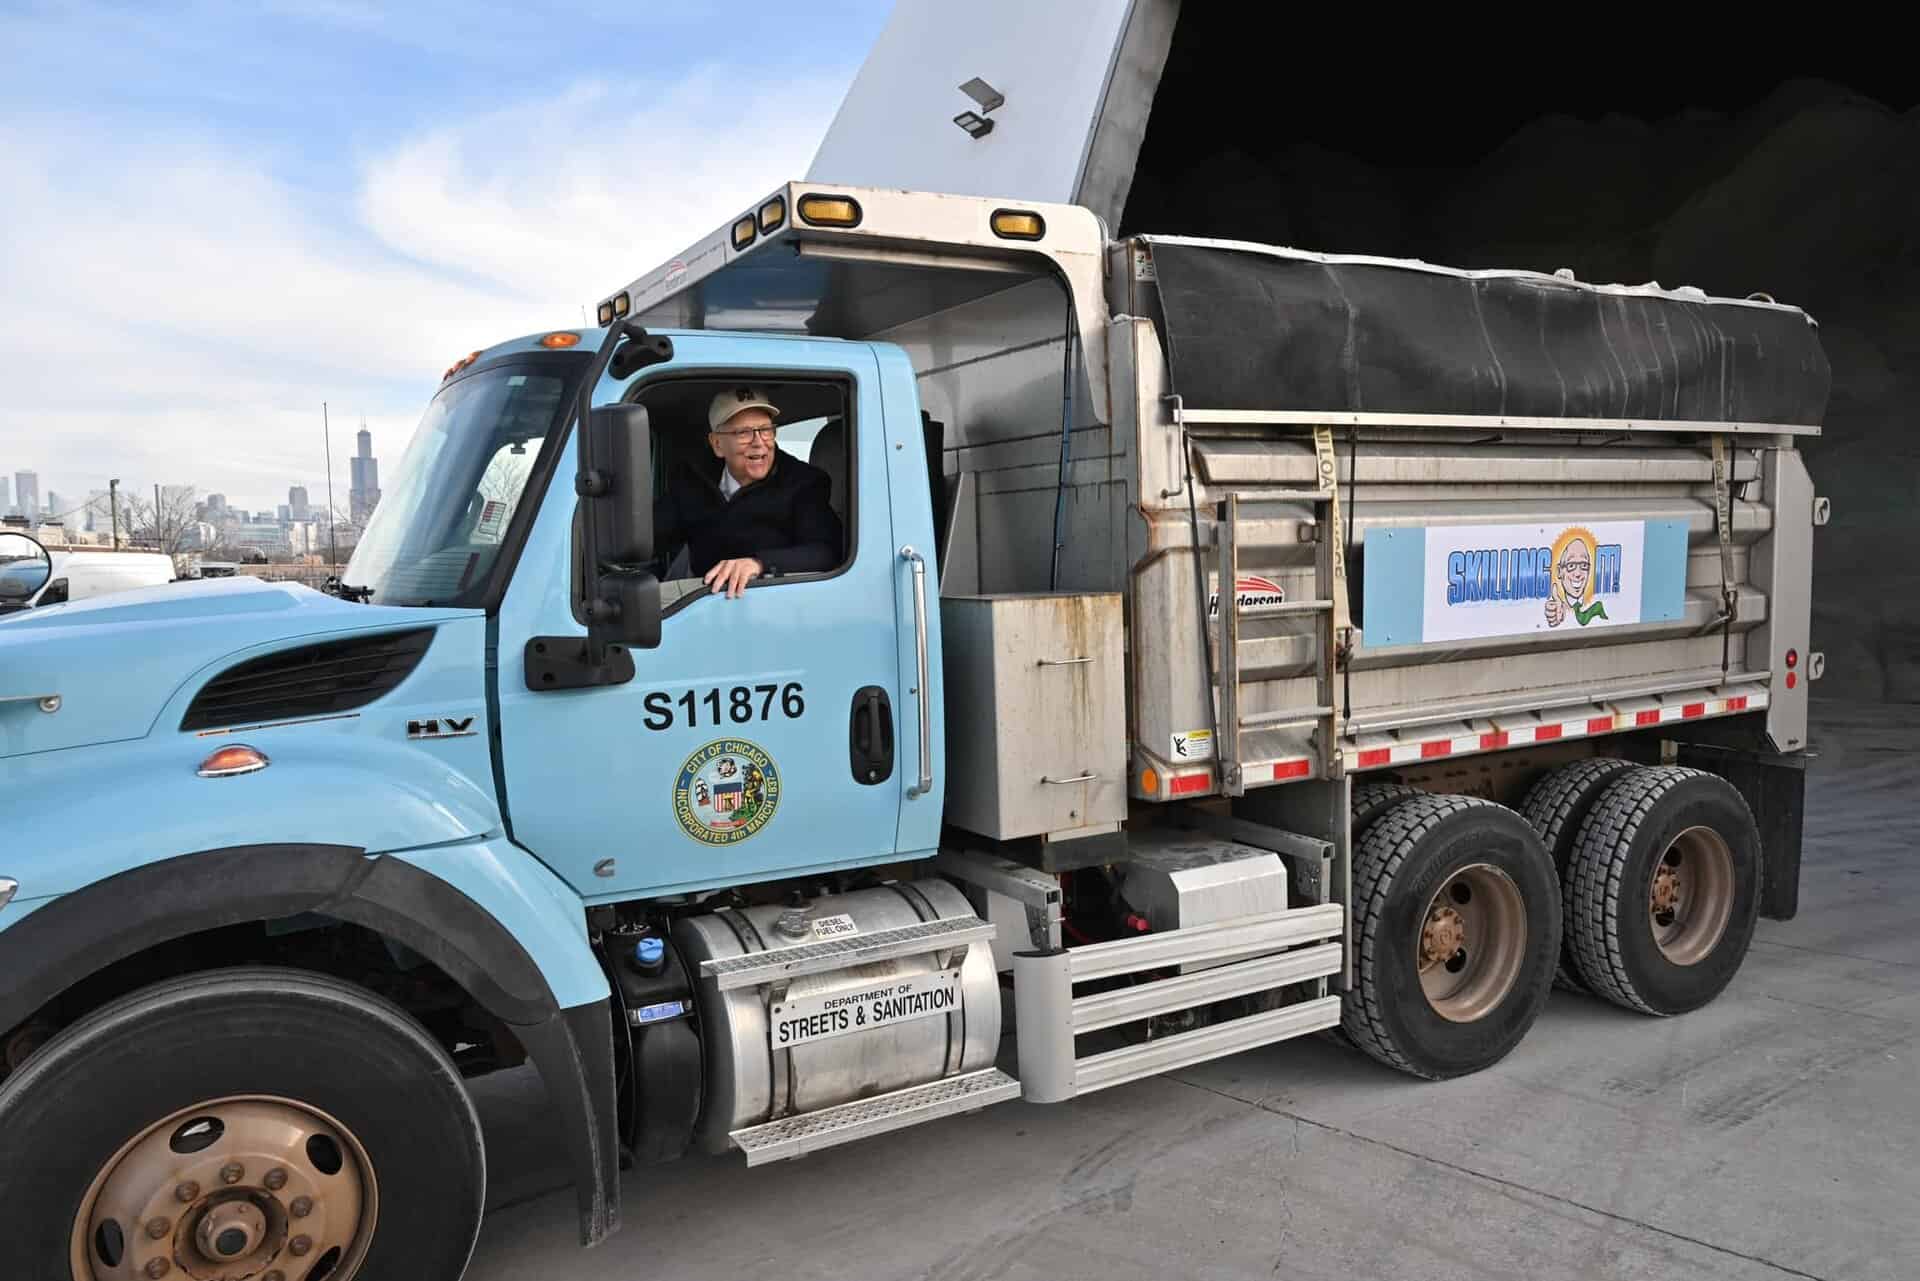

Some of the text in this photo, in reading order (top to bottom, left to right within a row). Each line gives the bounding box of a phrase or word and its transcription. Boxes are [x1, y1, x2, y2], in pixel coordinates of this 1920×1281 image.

[1447, 547, 1552, 606] SKILLING
[643, 682, 805, 731] S11876
[406, 716, 478, 735] HV
[686, 742, 768, 773] CITY OF CHICAGO
[677, 789, 728, 842] INCORPORATED
[746, 800, 776, 833] MARCH
[815, 923, 854, 936] FUEL ONLY
[818, 917, 845, 928] DIESEL
[824, 983, 913, 1010] DEPARTMENT OF
[779, 987, 955, 1042] STREETS & SANITATION
